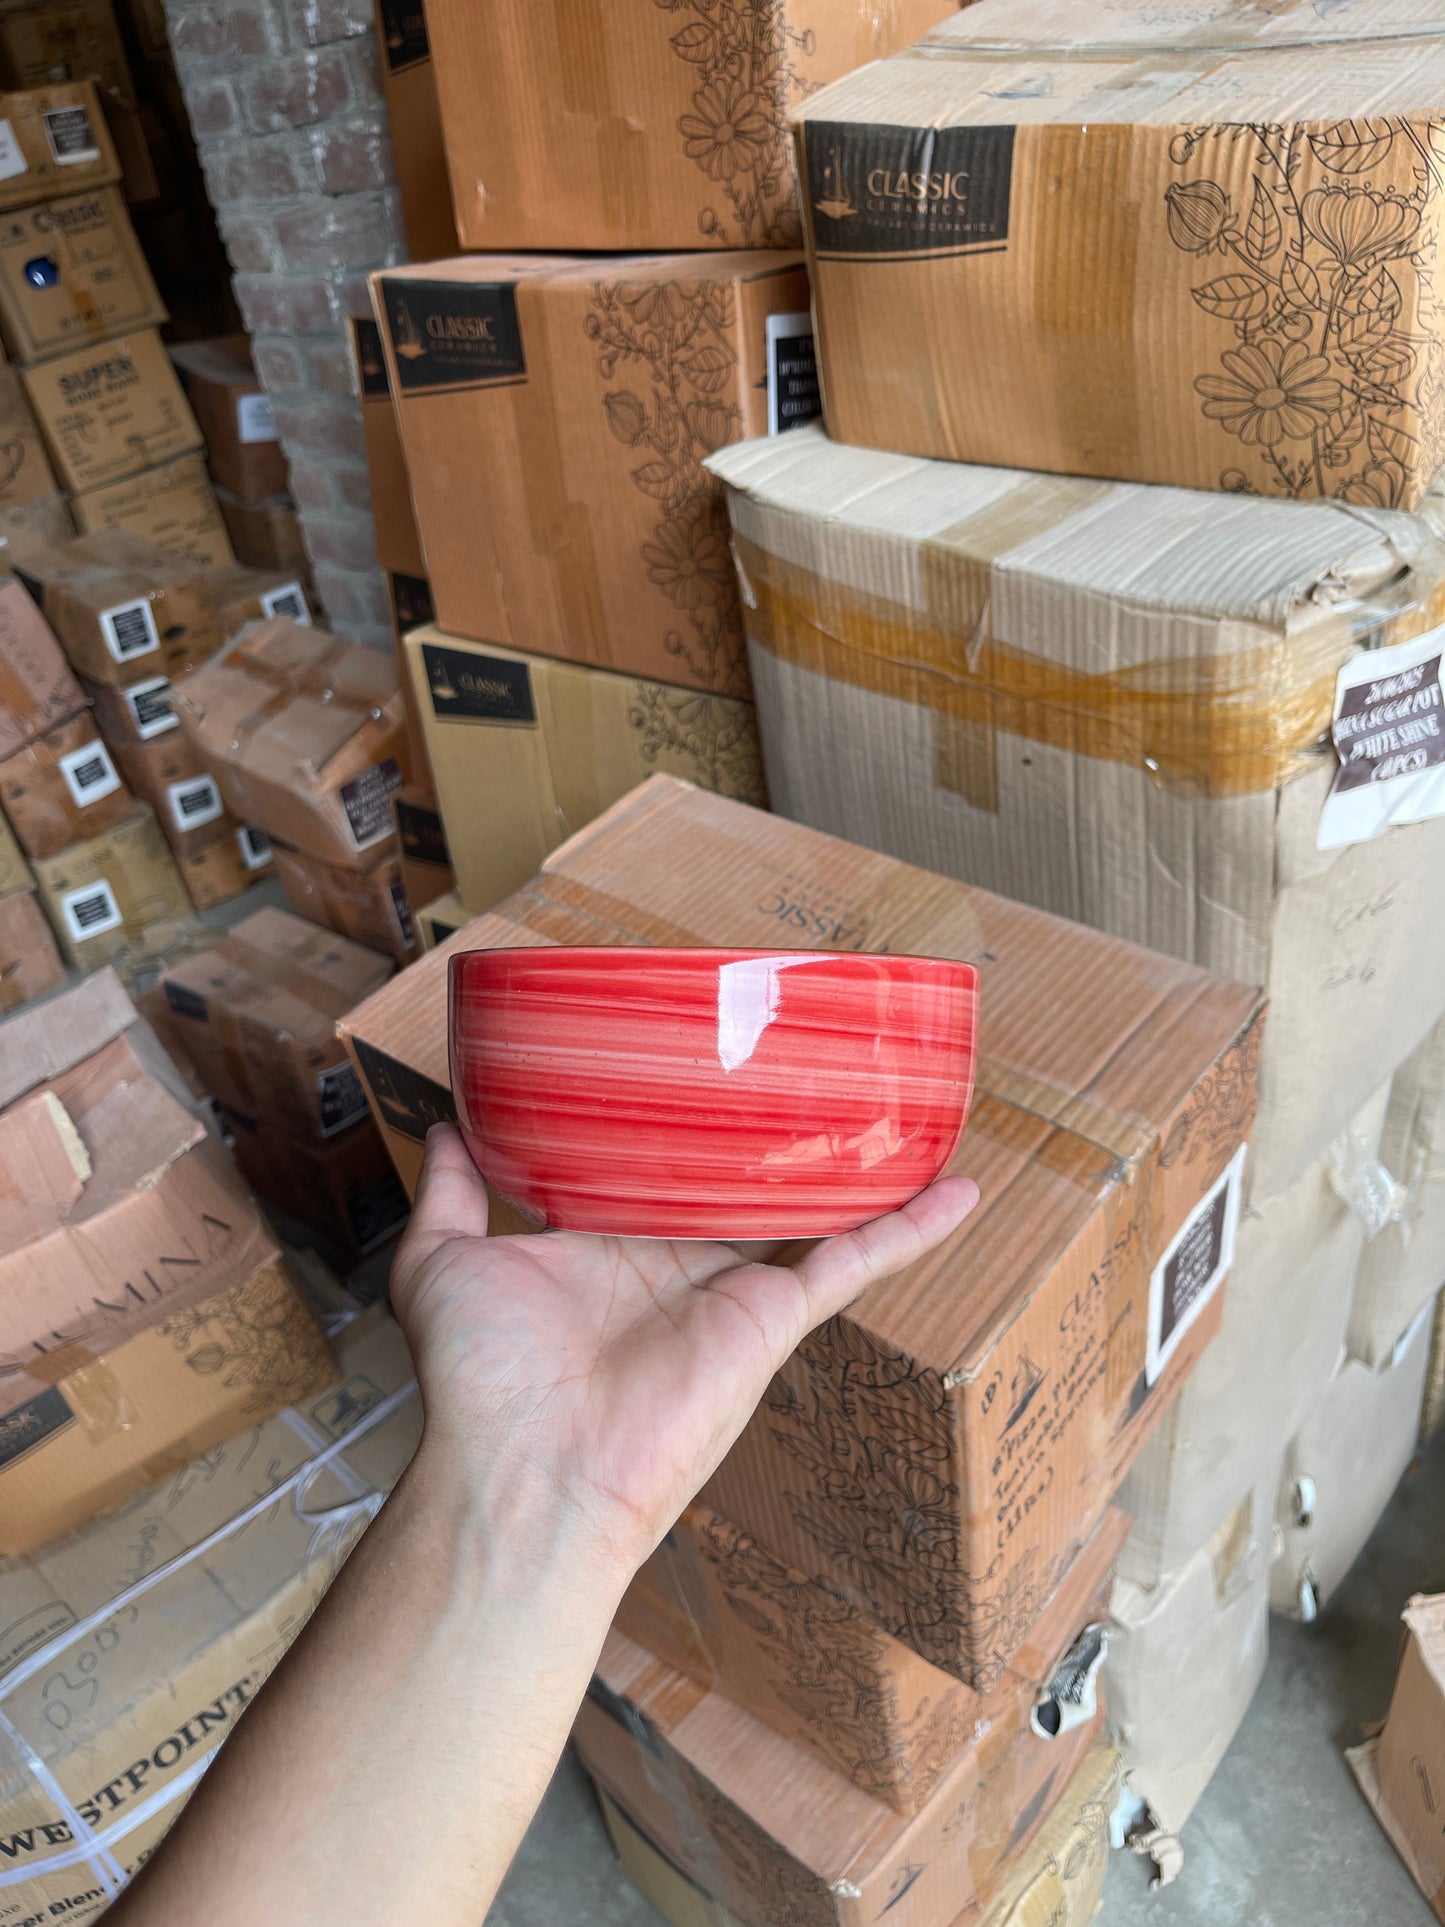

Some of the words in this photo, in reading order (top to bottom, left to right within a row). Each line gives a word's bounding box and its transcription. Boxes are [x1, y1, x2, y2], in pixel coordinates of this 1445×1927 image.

[866, 168, 970, 201] CLASSIC
[865, 198, 968, 217] CERAMICS
[425, 313, 497, 342] CLASSIC
[57, 356, 139, 396] SUPER
[1401, 713, 1440, 746] SHINE
[0, 1676, 252, 1860] WESTPOINT
